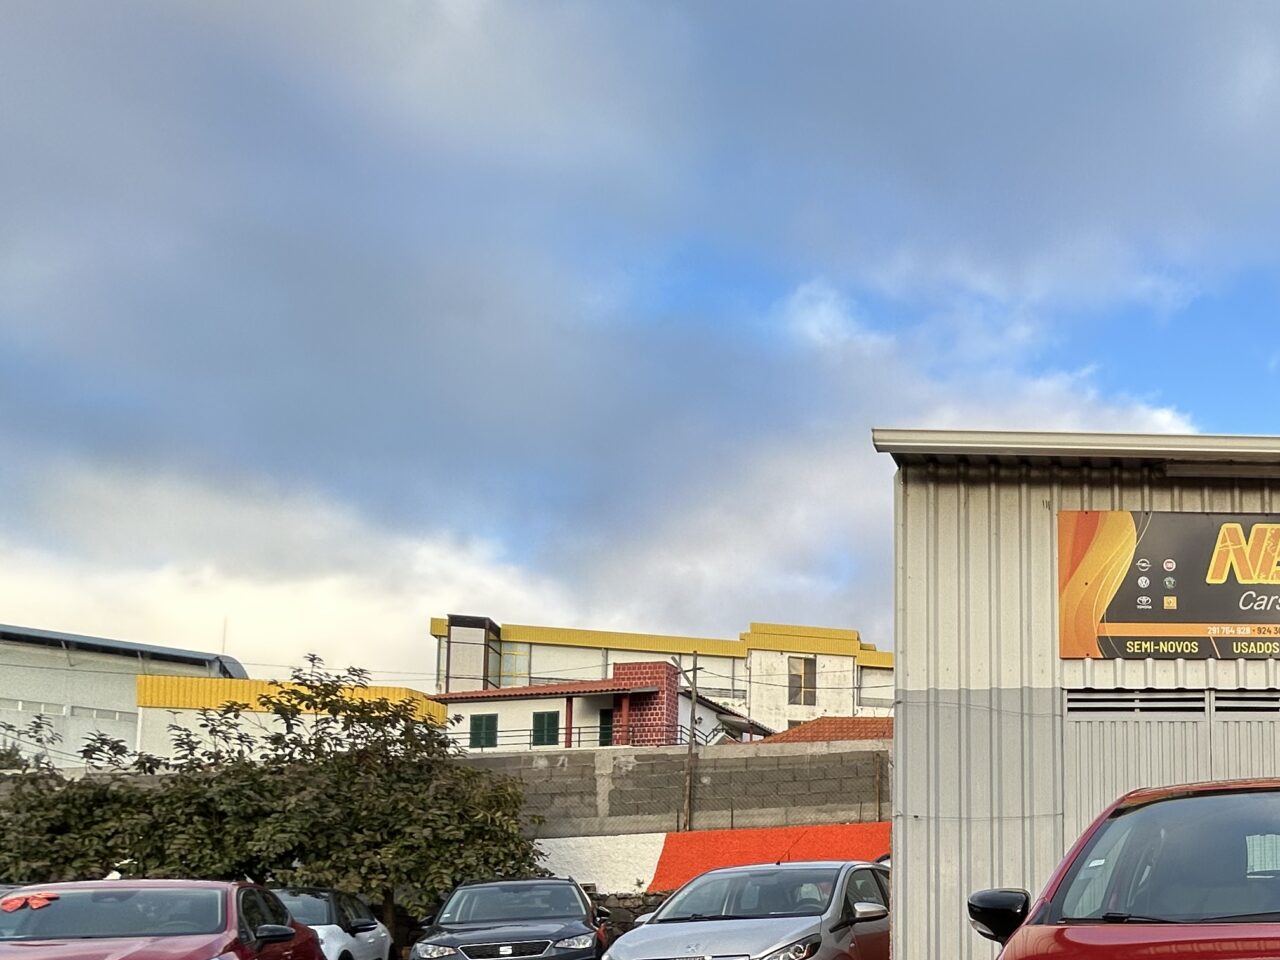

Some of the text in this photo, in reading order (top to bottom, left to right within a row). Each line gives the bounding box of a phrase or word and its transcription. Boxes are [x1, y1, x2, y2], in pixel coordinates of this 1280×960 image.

[1207, 626, 1220, 635] 291
[1257, 626, 1272, 635] 924
[1126, 641, 1199, 653] SEMI-NOVOS
[1232, 641, 1280, 654] USADOS
